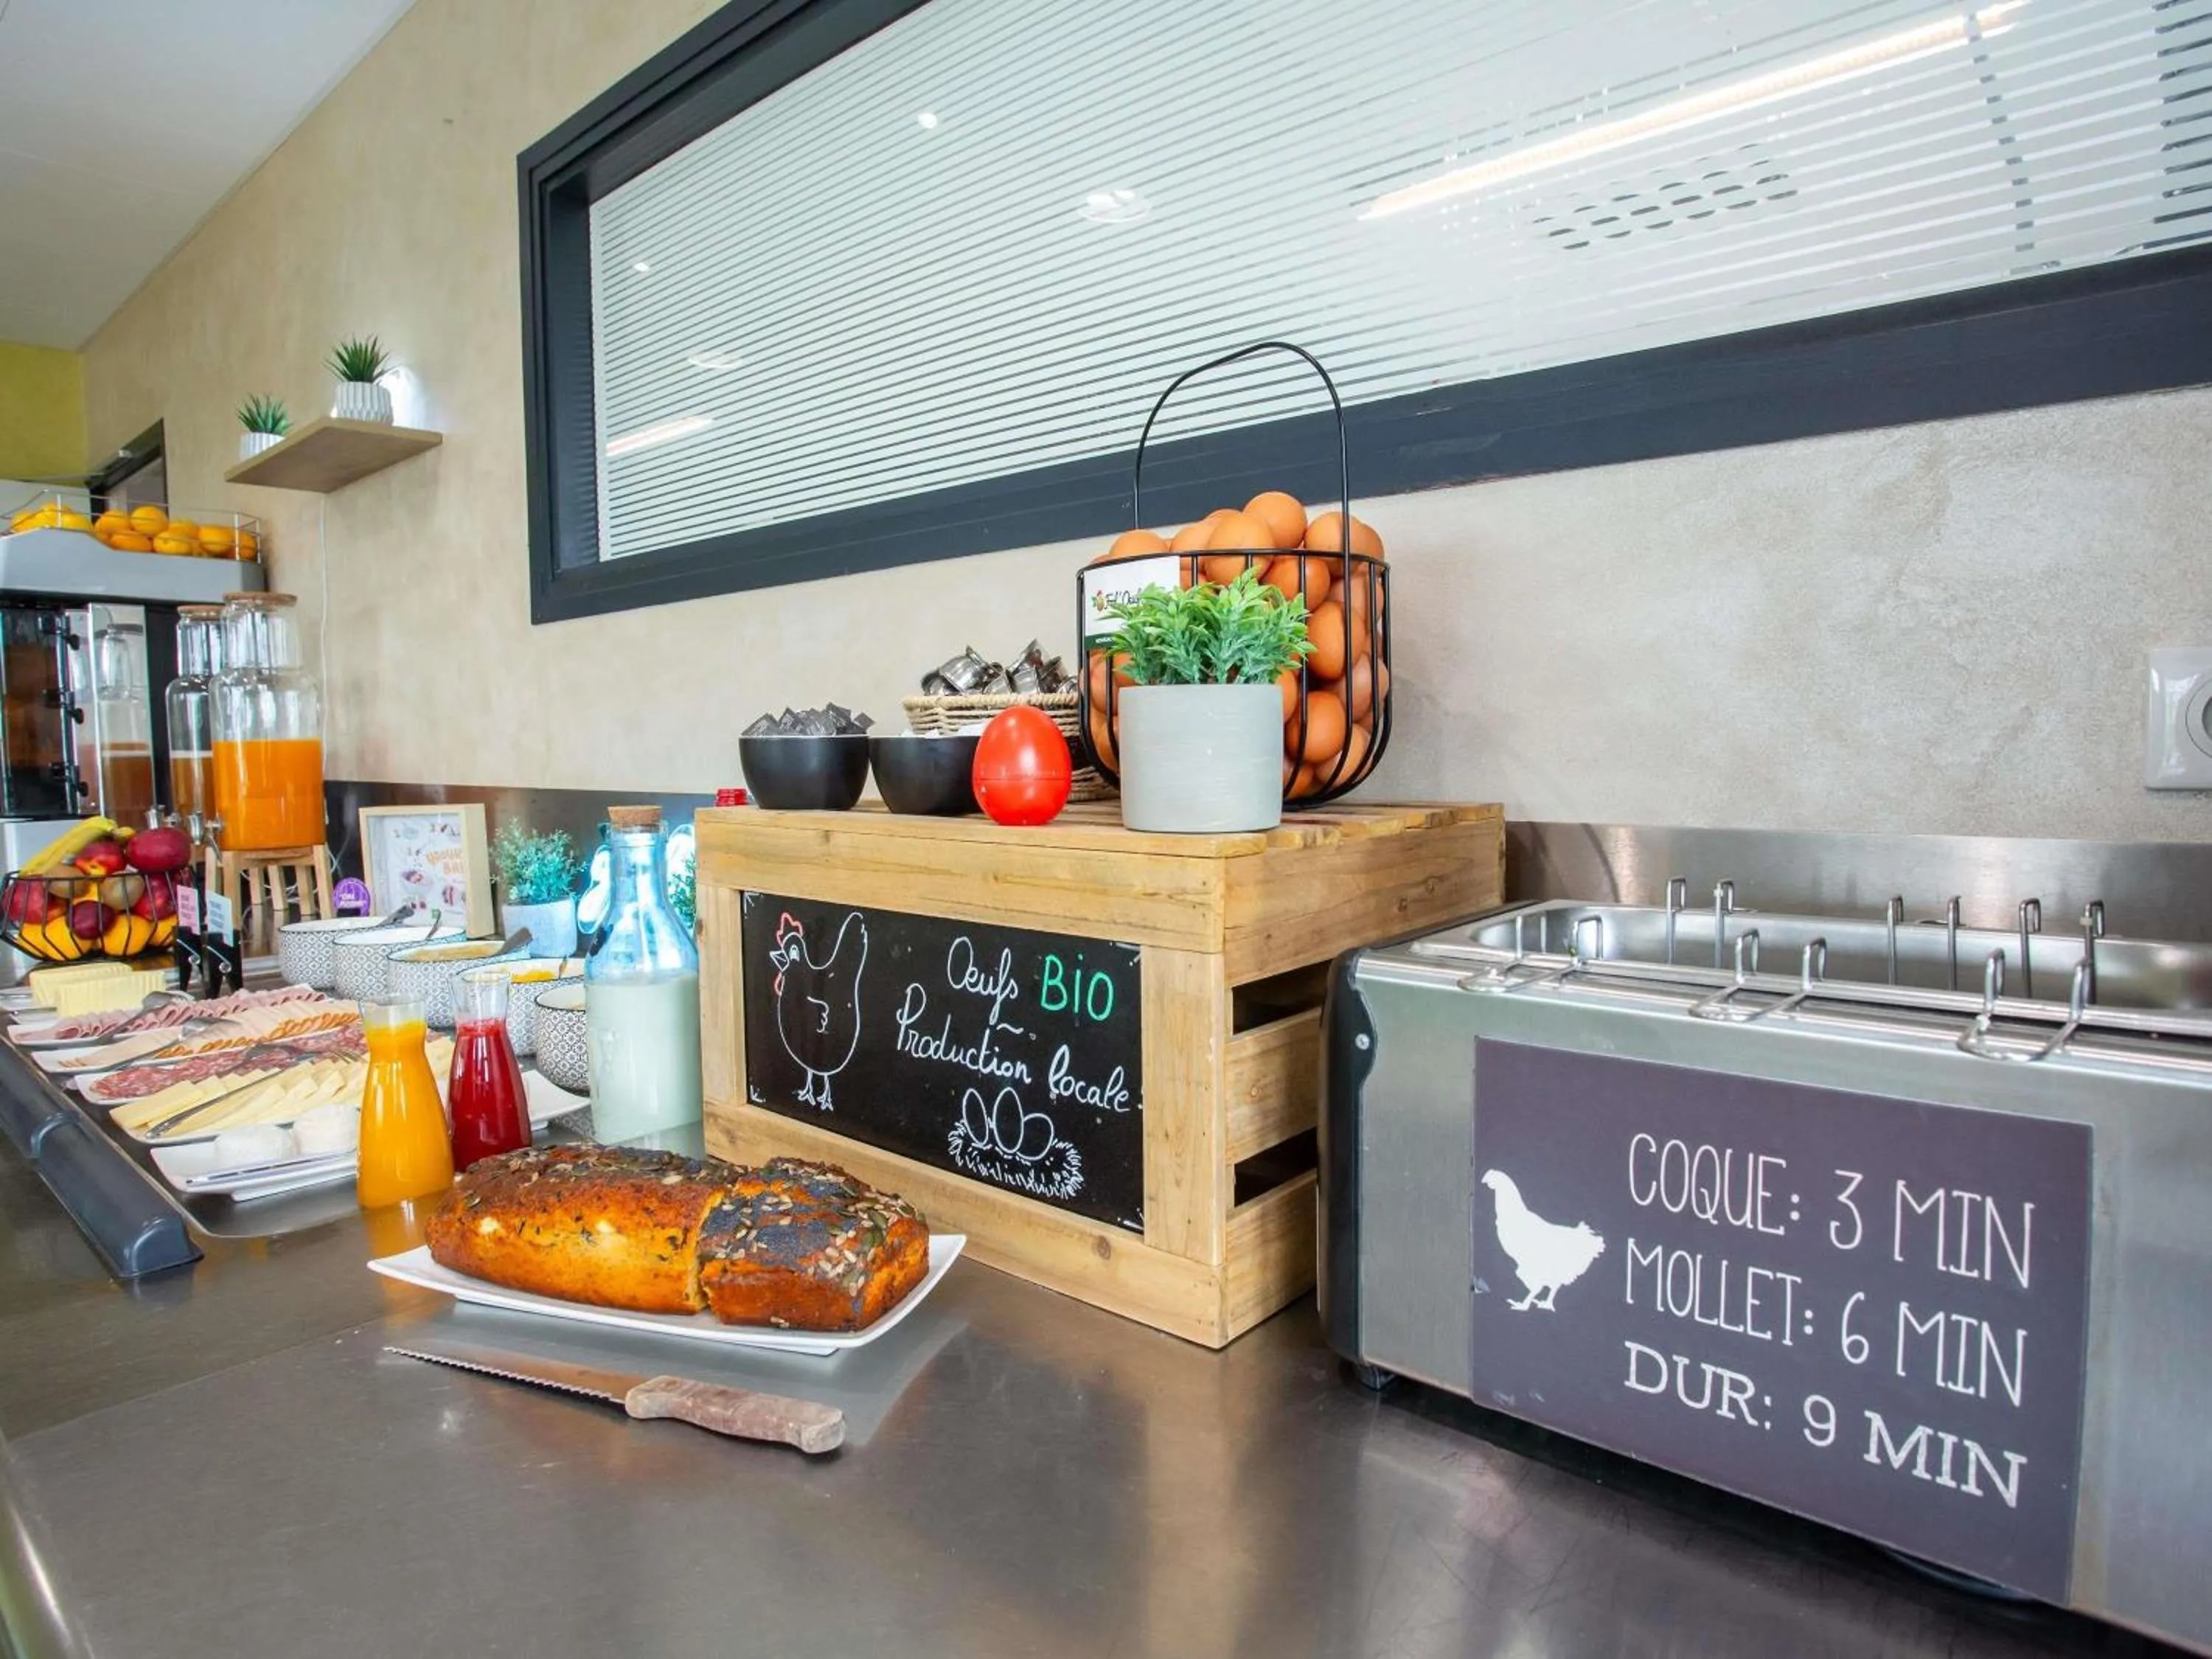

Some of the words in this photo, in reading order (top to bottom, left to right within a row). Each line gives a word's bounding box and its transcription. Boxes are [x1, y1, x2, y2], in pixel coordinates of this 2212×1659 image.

[897, 983, 1031, 1084] Production
[1629, 1133, 1801, 1235] COQUE:
[1830, 1169, 1863, 1249] 3
[1893, 1180, 2035, 1289] MIN
[1626, 1237, 1814, 1346] MOLLET:
[1841, 1292, 1869, 1365] 6
[1896, 1301, 2028, 1408] MIN
[1624, 1341, 1772, 1430] DUR:
[1803, 1395, 1837, 1447] 9
[1863, 1410, 2028, 1509] MIN
